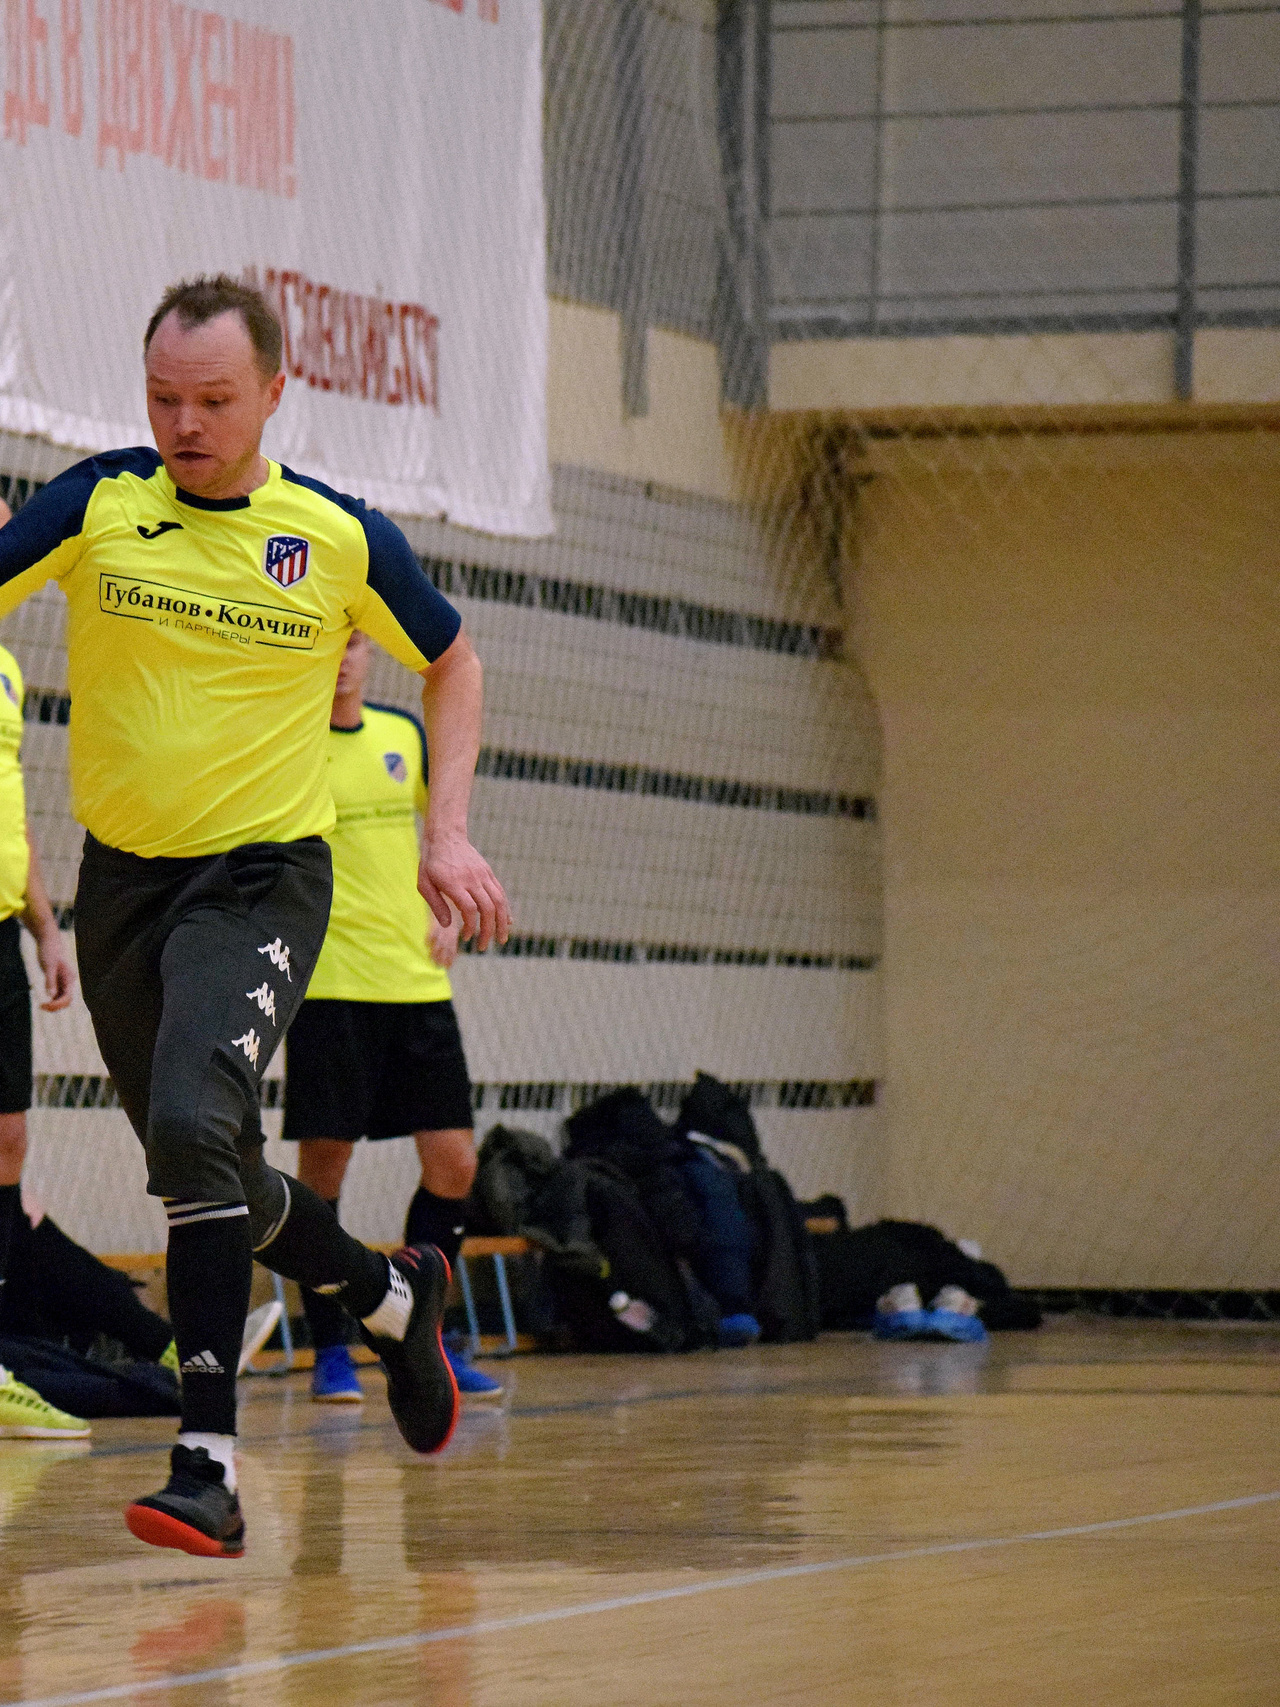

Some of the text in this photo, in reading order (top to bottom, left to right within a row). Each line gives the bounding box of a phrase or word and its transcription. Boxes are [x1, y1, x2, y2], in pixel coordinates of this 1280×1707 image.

[60, 0, 83, 138] В
[105, 581, 312, 639] Губанов Колчин
[158, 616, 251, 645] И ПАРТНЕРЫ
